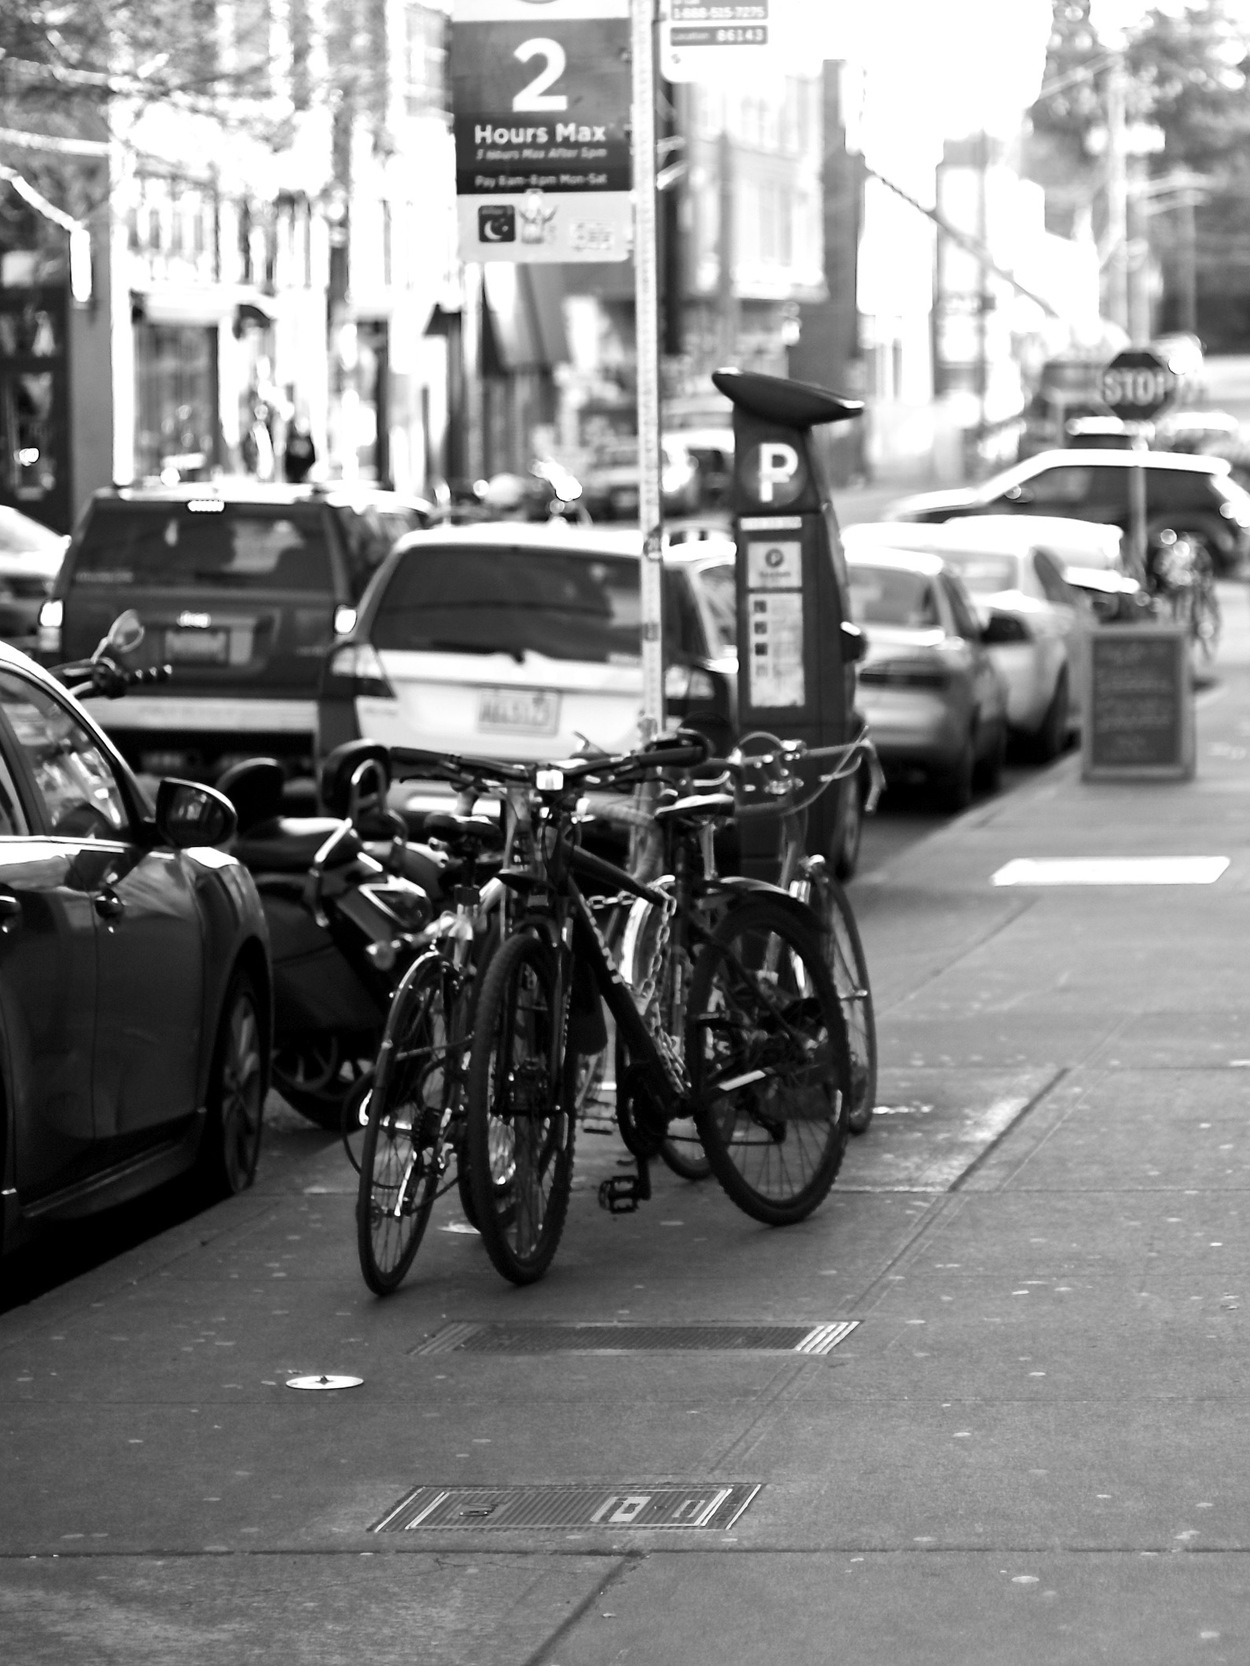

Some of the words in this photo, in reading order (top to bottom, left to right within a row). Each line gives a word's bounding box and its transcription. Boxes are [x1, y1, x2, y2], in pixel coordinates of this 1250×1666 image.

[512, 37, 568, 113] 2
[474, 124, 549, 145] Hours
[555, 122, 607, 143] Max
[760, 442, 799, 503] P
